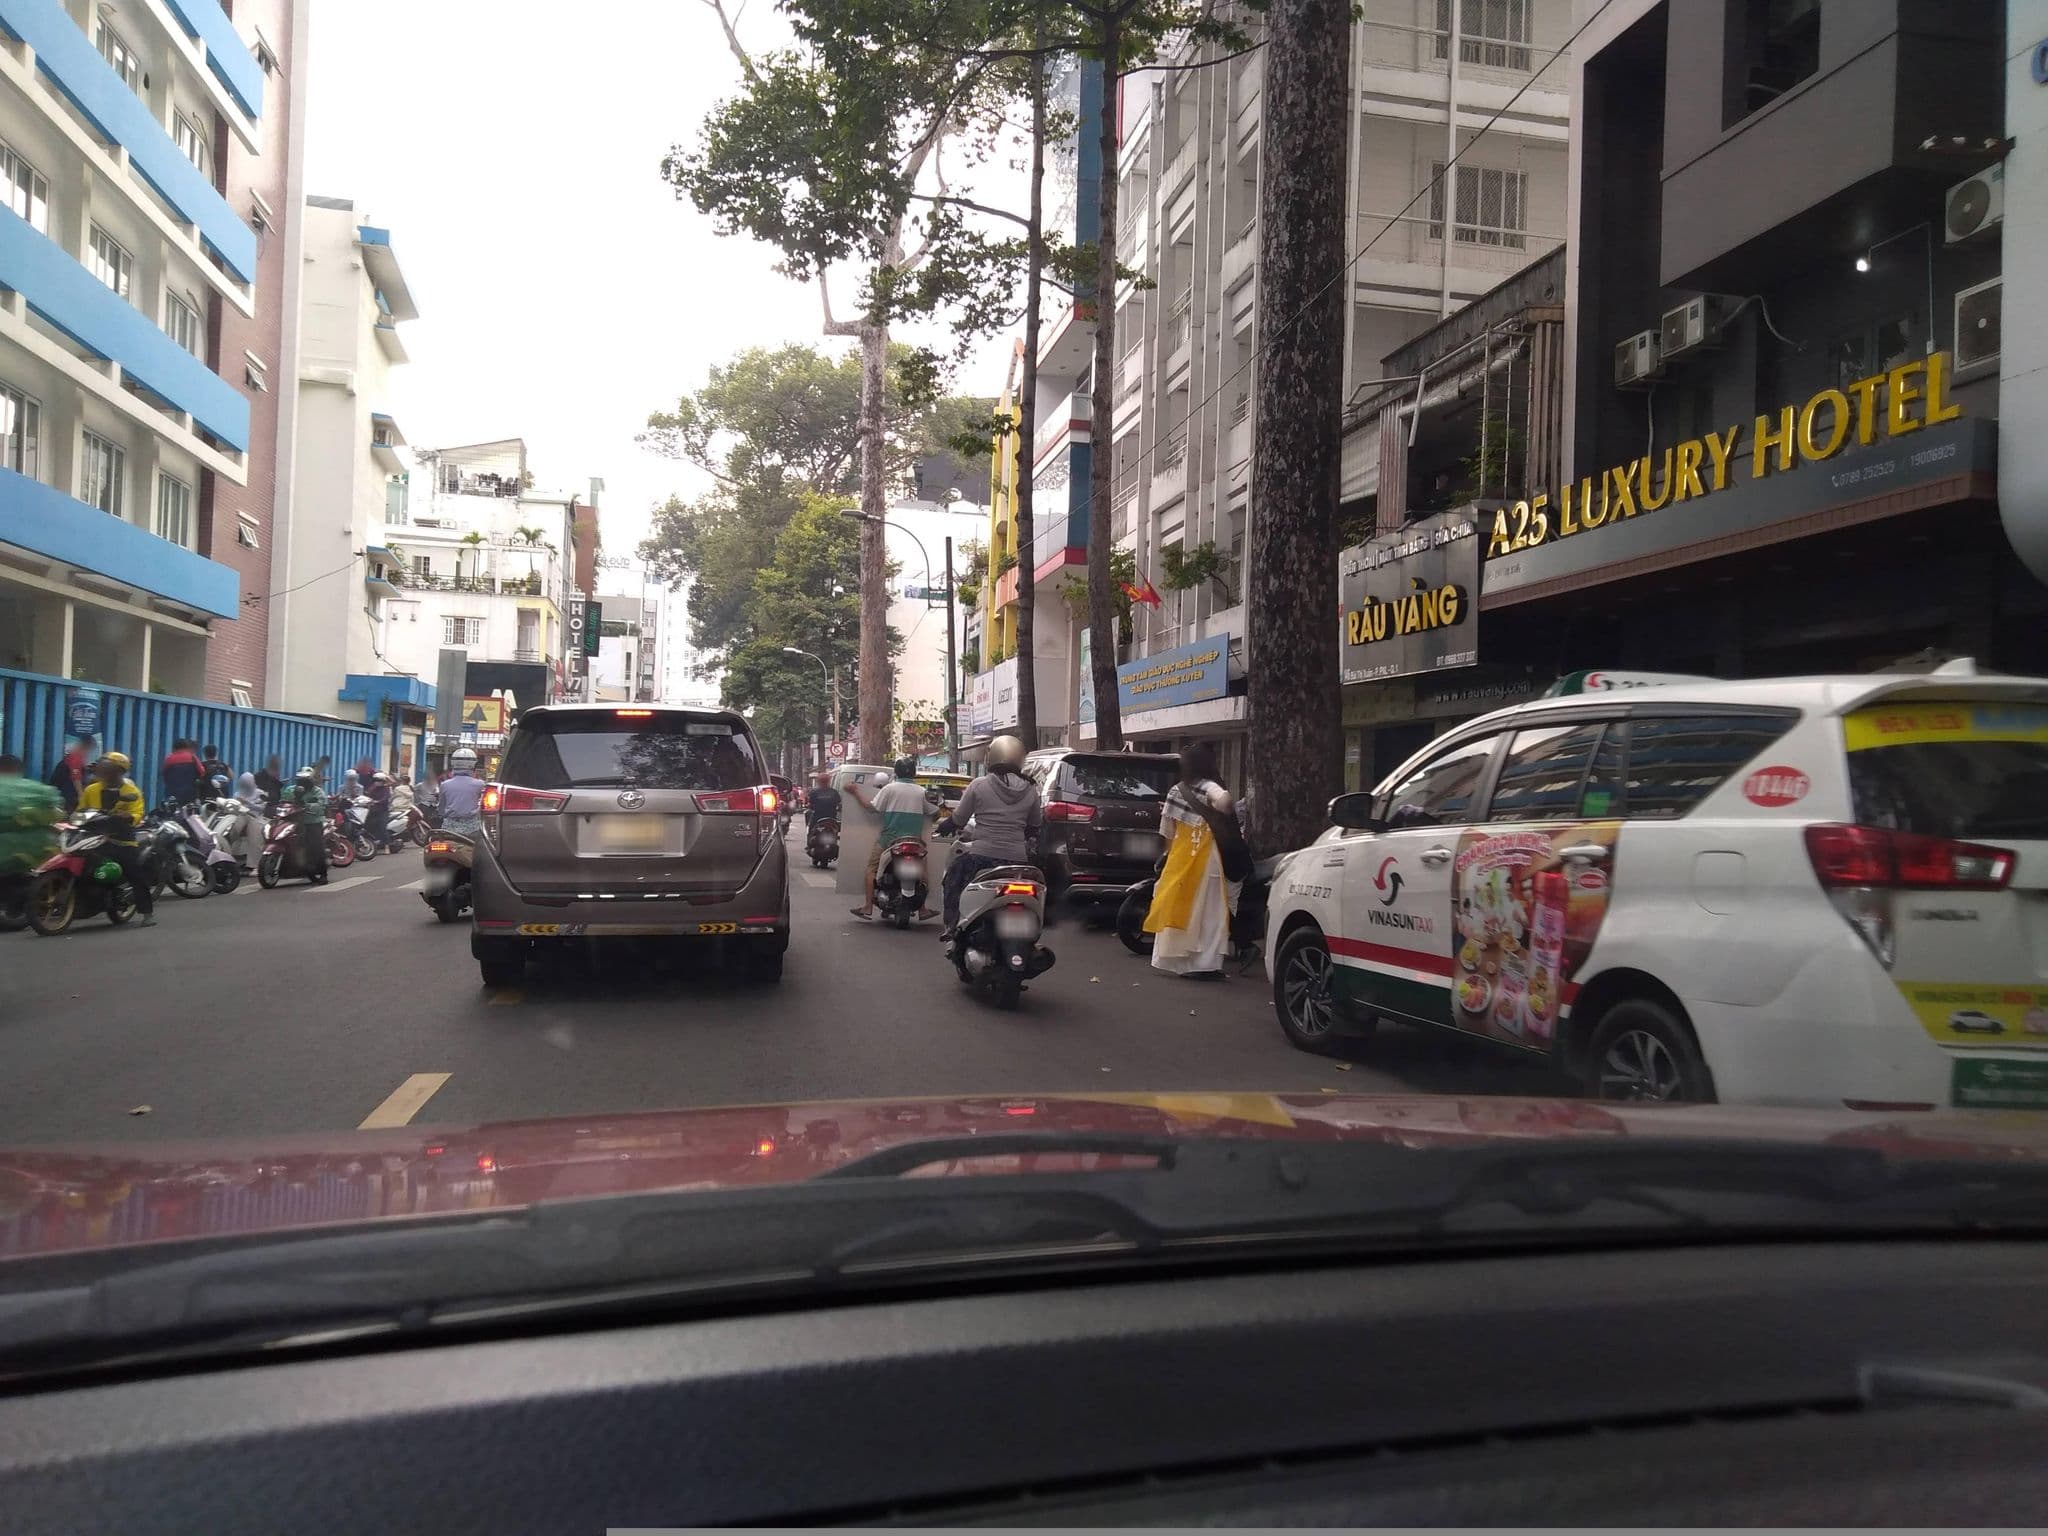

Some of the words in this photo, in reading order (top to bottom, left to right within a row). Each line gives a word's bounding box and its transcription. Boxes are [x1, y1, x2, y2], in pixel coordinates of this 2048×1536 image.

[1486, 493, 1548, 559] A25
[1560, 424, 1739, 537] LUXURY
[1752, 351, 1960, 480] HOTEL
[570, 602, 583, 674] HOTEL
[1347, 595, 1387, 646] RÂU
[1392, 577, 1459, 636] VÀNG
